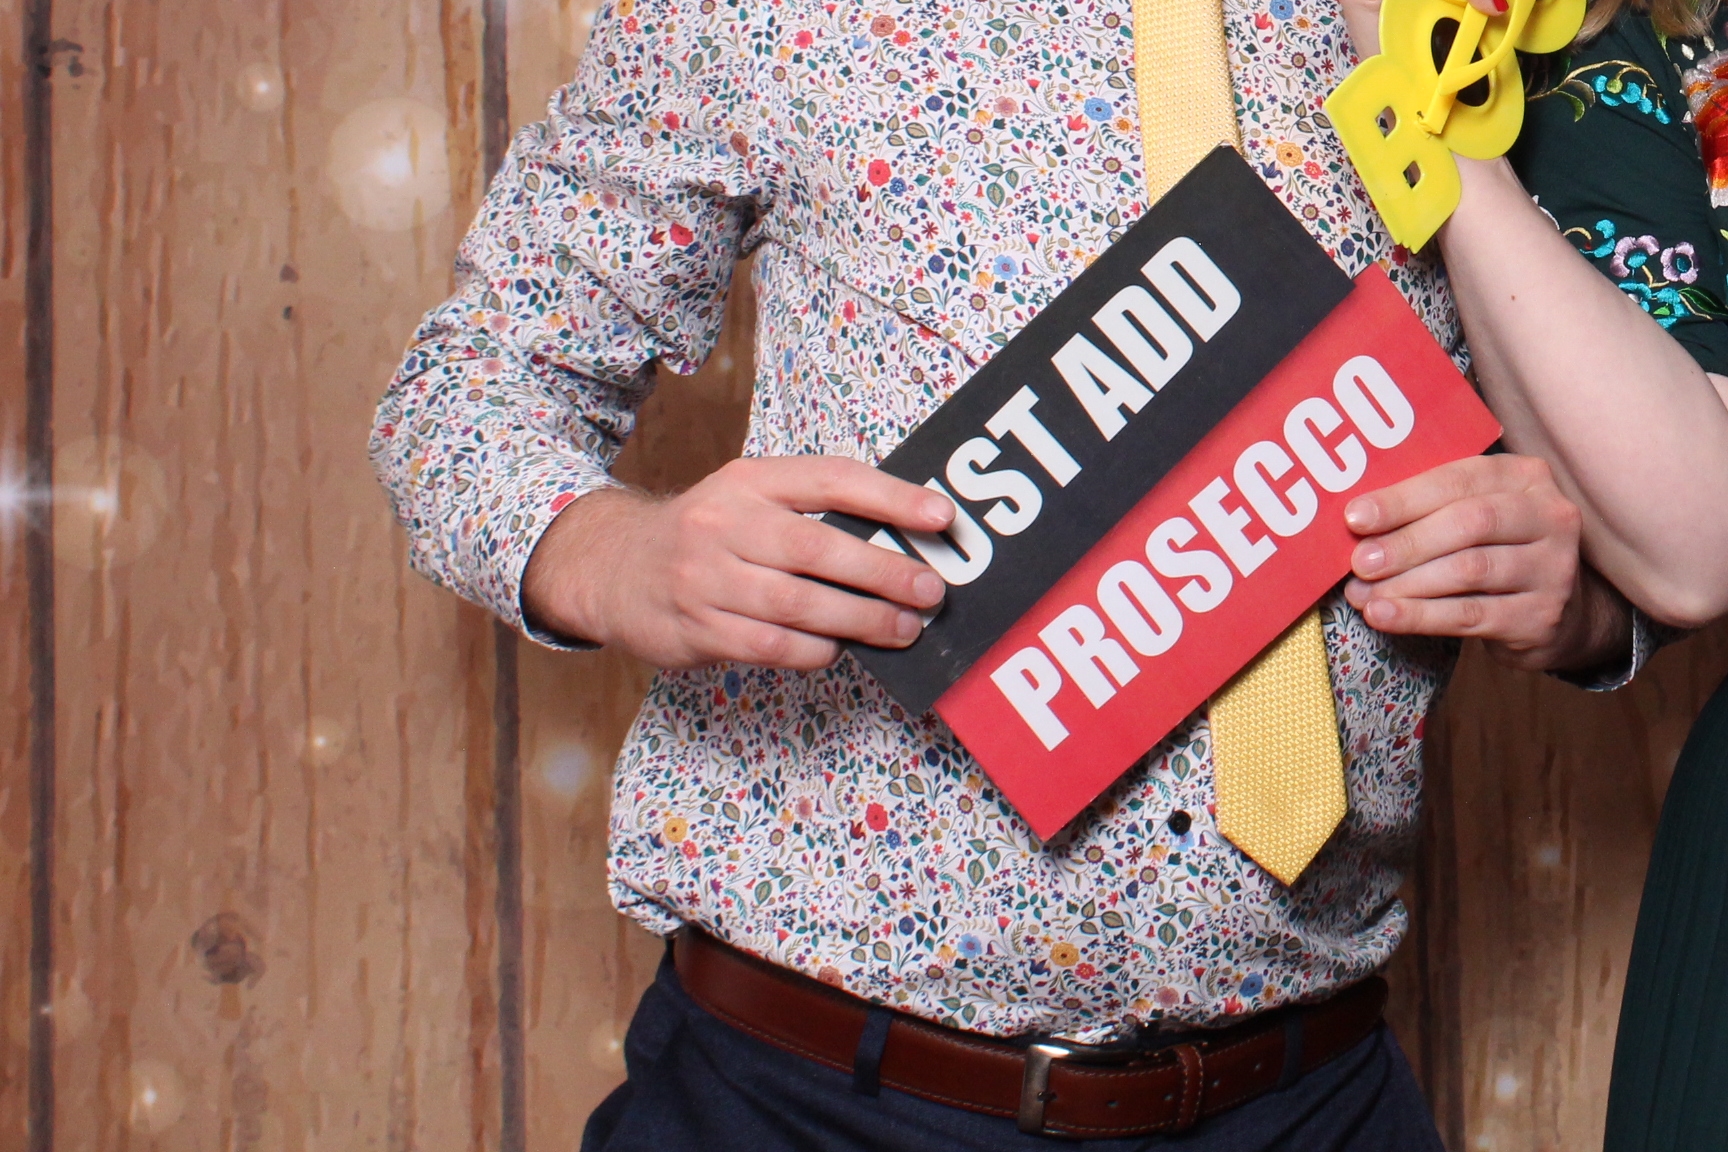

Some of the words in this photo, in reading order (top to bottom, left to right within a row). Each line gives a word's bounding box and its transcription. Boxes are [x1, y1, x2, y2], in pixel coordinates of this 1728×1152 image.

[867, 384, 1083, 630] UST
[1050, 235, 1242, 443] ADD
[988, 354, 1416, 752] PROSECCO
